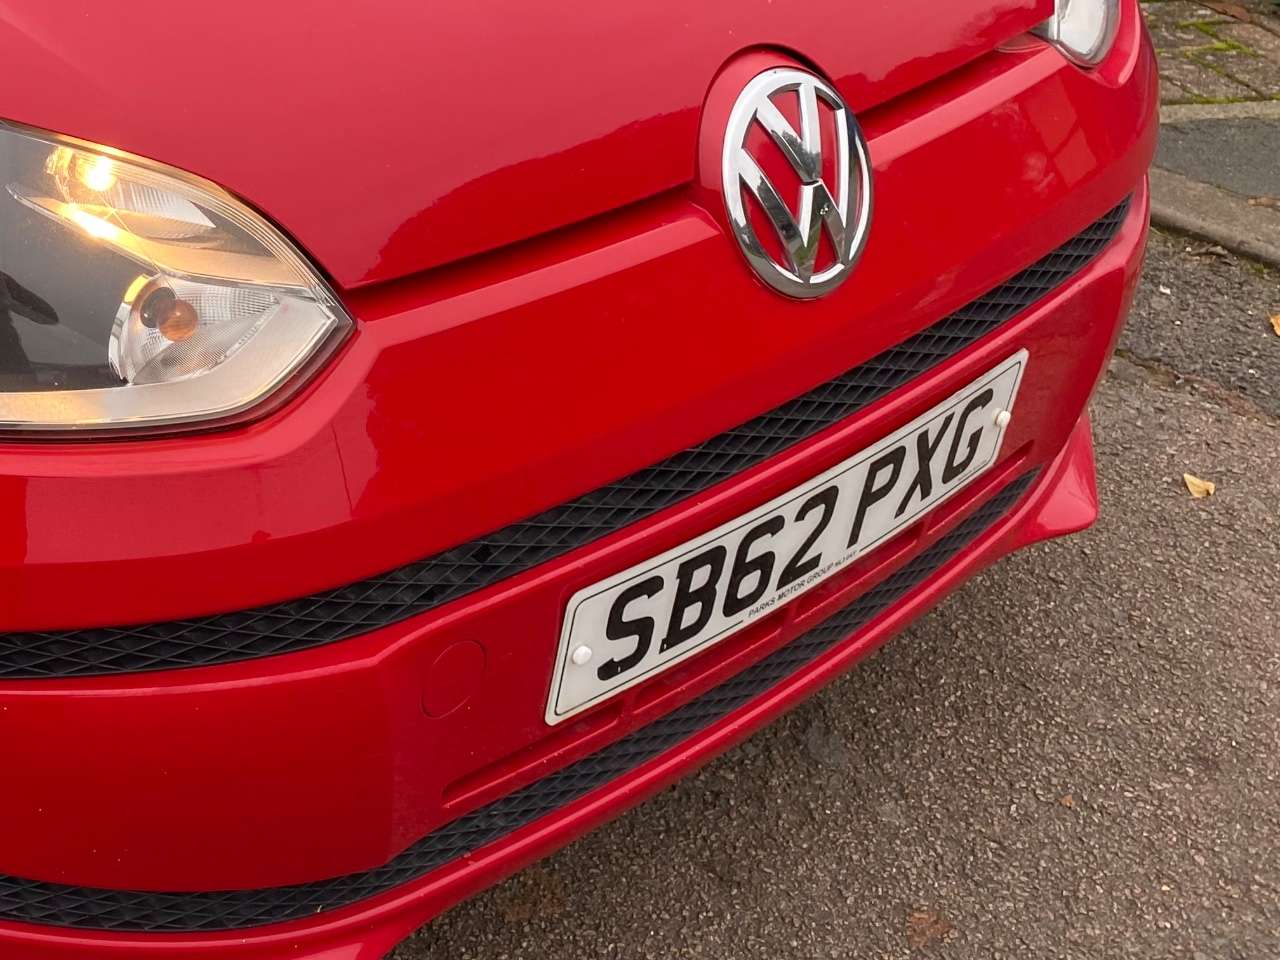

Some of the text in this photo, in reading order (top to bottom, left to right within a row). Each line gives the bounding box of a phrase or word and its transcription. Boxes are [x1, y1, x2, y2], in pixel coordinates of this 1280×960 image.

[597, 388, 995, 682] SB62 PXG
[748, 596, 776, 618] PARKS
[777, 579, 806, 601] MOTOR
[806, 562, 834, 584] GROUP
